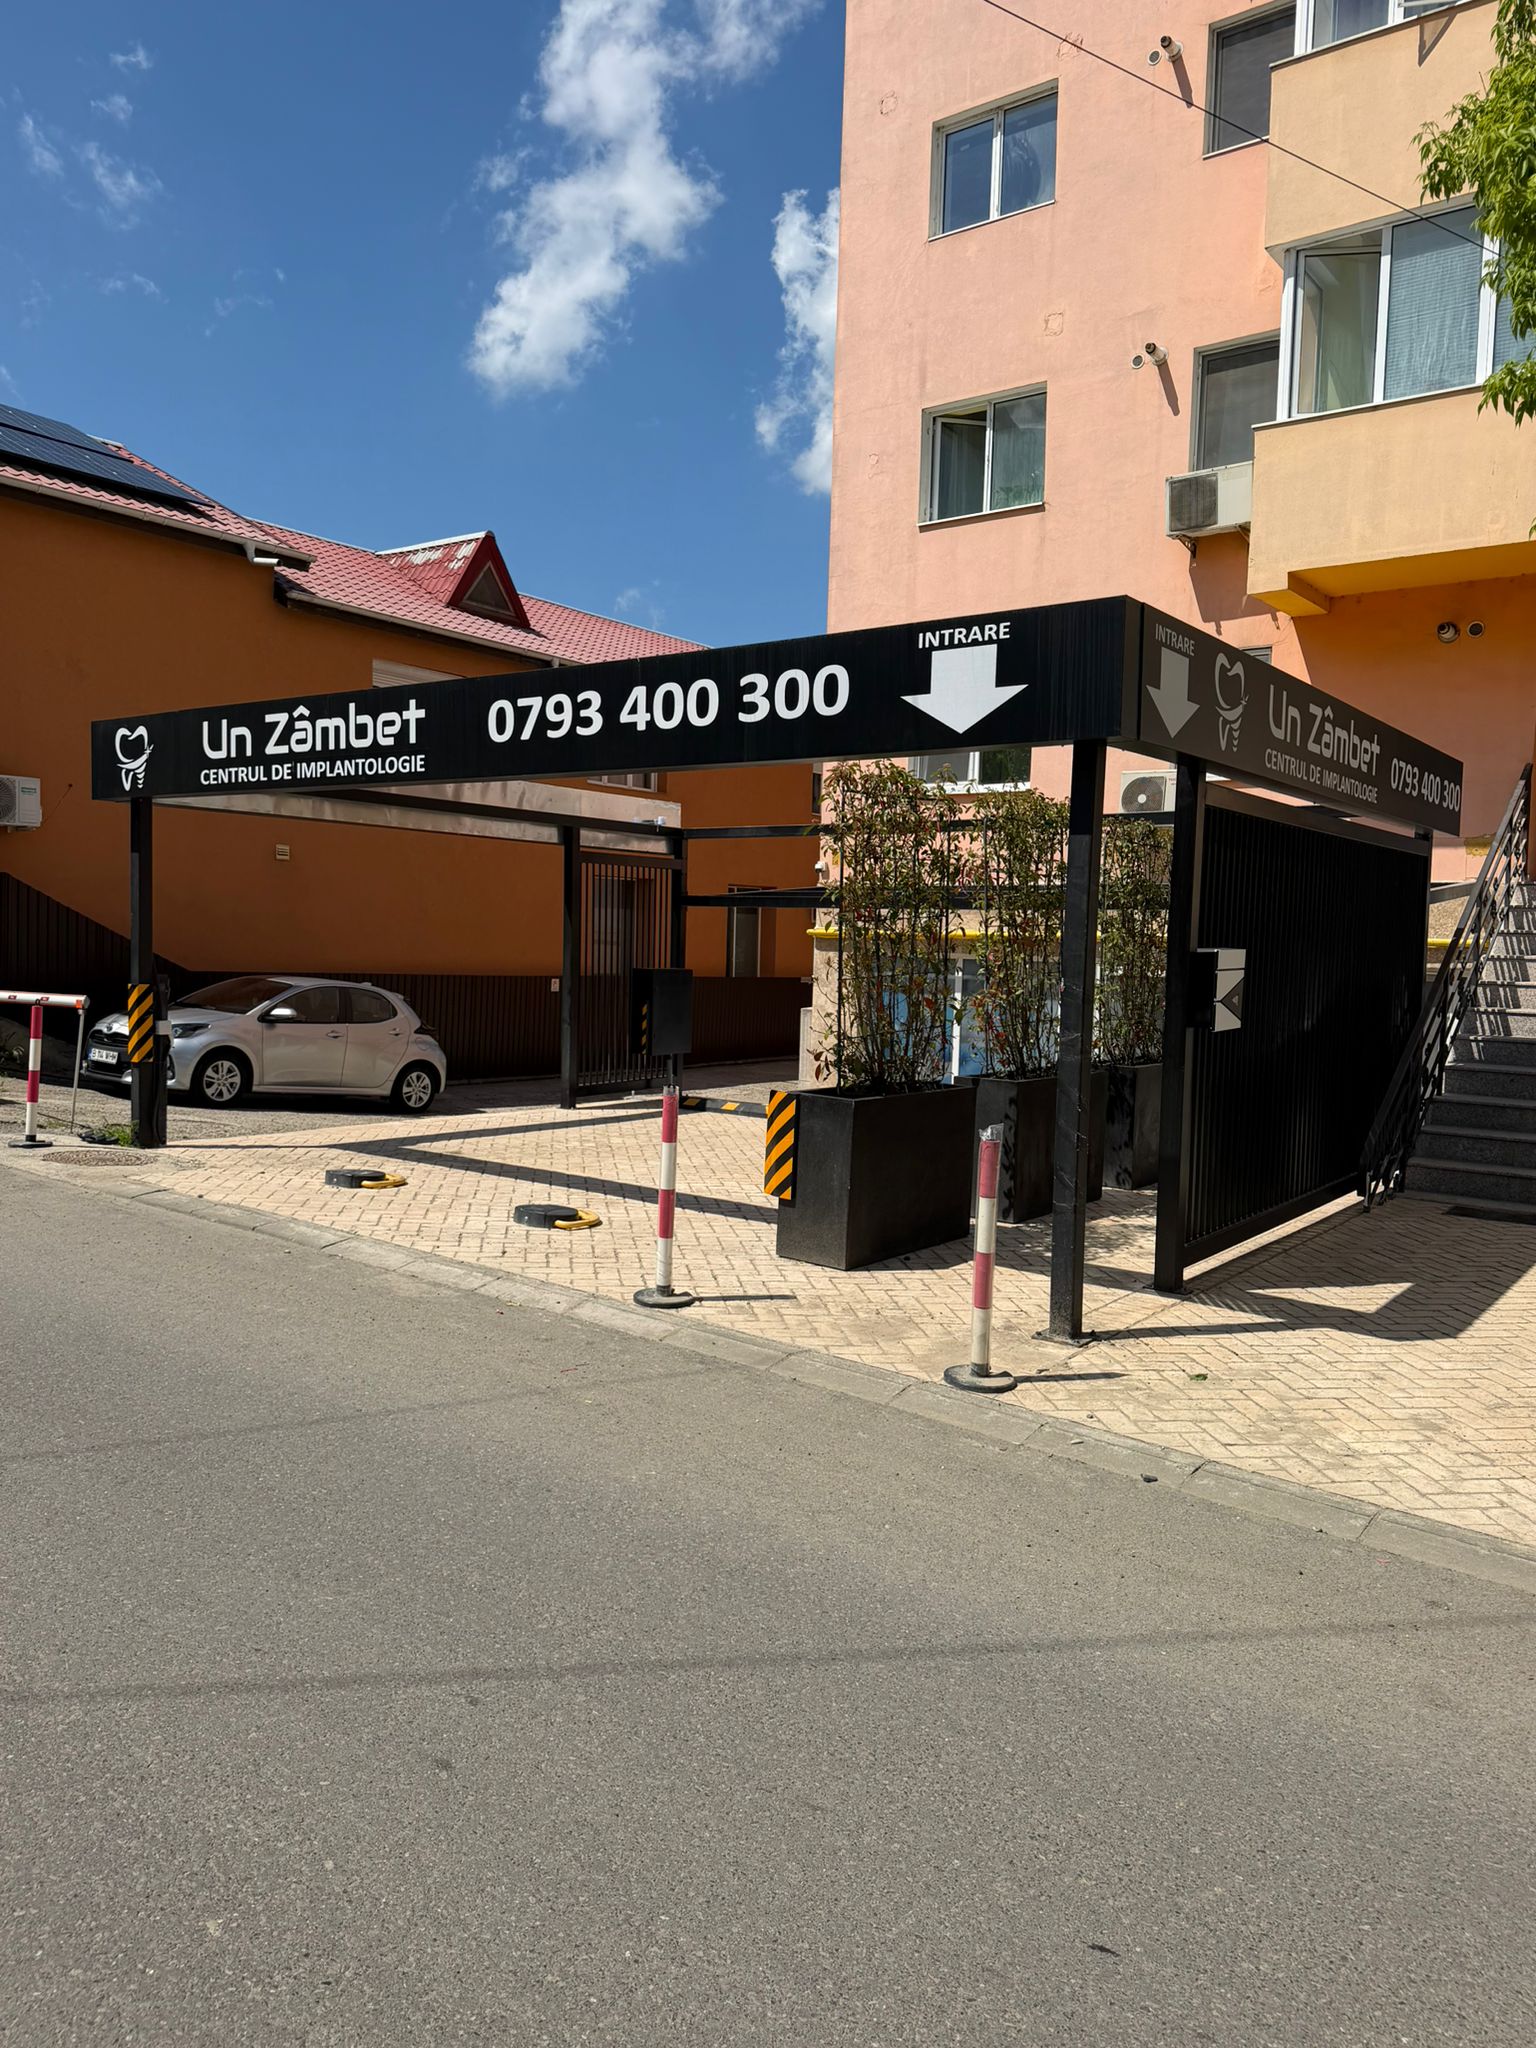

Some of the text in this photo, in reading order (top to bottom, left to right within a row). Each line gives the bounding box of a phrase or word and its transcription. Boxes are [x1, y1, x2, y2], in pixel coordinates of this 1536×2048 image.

[918, 621, 1011, 649] INTRARE
[1155, 623, 1196, 657] INTRARE
[202, 698, 426, 760] Un Zâmbet
[487, 664, 850, 743] 0793 400 300
[1268, 683, 1381, 777] Un Zâmbet
[200, 754, 426, 785] CENTRUL DE IMPLANTOLOGIE
[1264, 748, 1378, 804] CENTRUL DE IMPLANTOLOGIE
[1390, 757, 1461, 813] 0793 400 300
